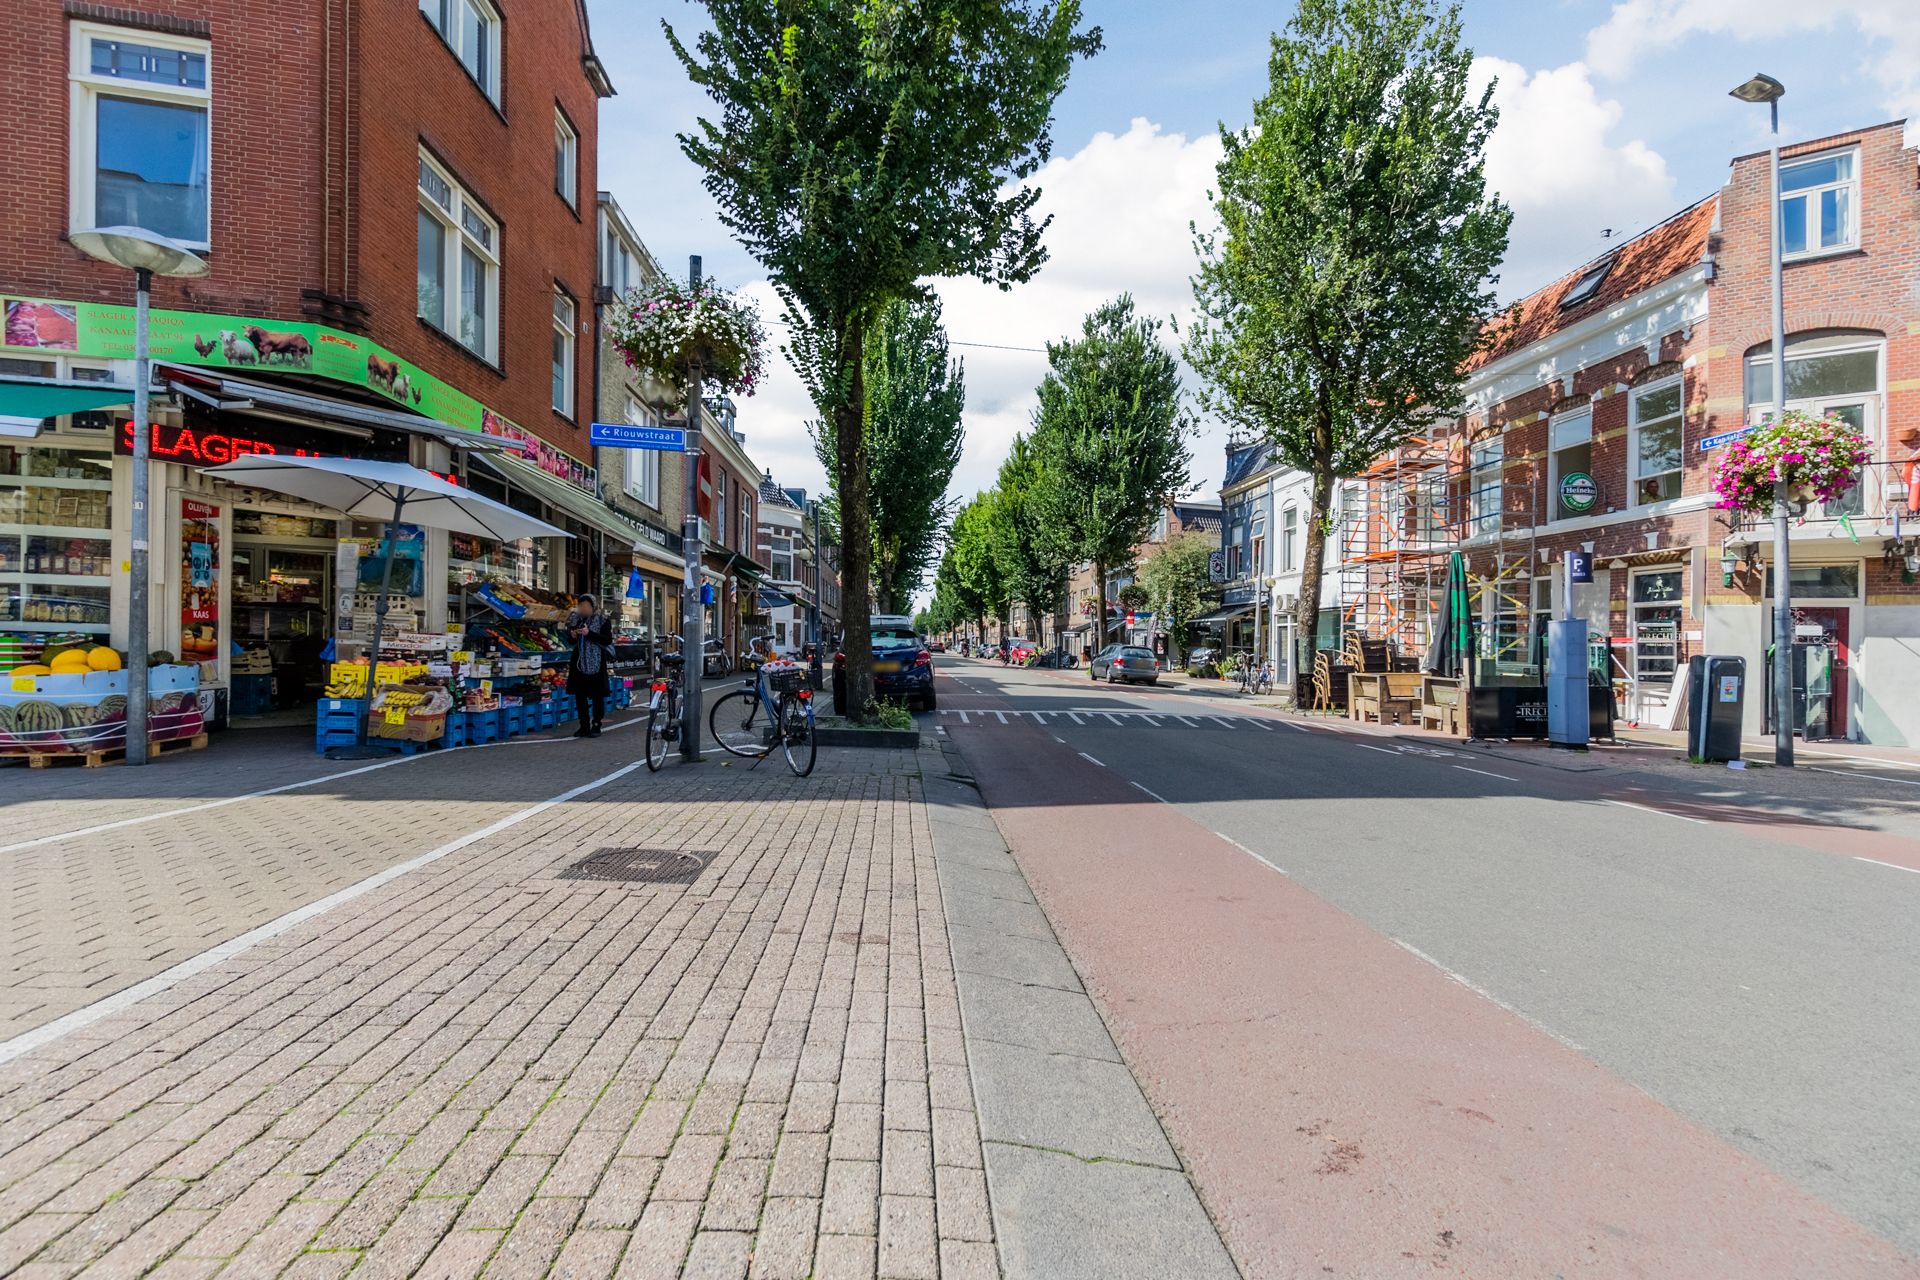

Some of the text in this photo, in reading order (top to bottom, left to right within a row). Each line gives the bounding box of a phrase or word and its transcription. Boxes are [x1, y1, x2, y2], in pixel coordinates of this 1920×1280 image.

[87, 311, 127, 321] SLAGER
[613, 428, 675, 440] Riouwstraat
[1573, 558, 1584, 570] P
[192, 610, 210, 619] KAAS
